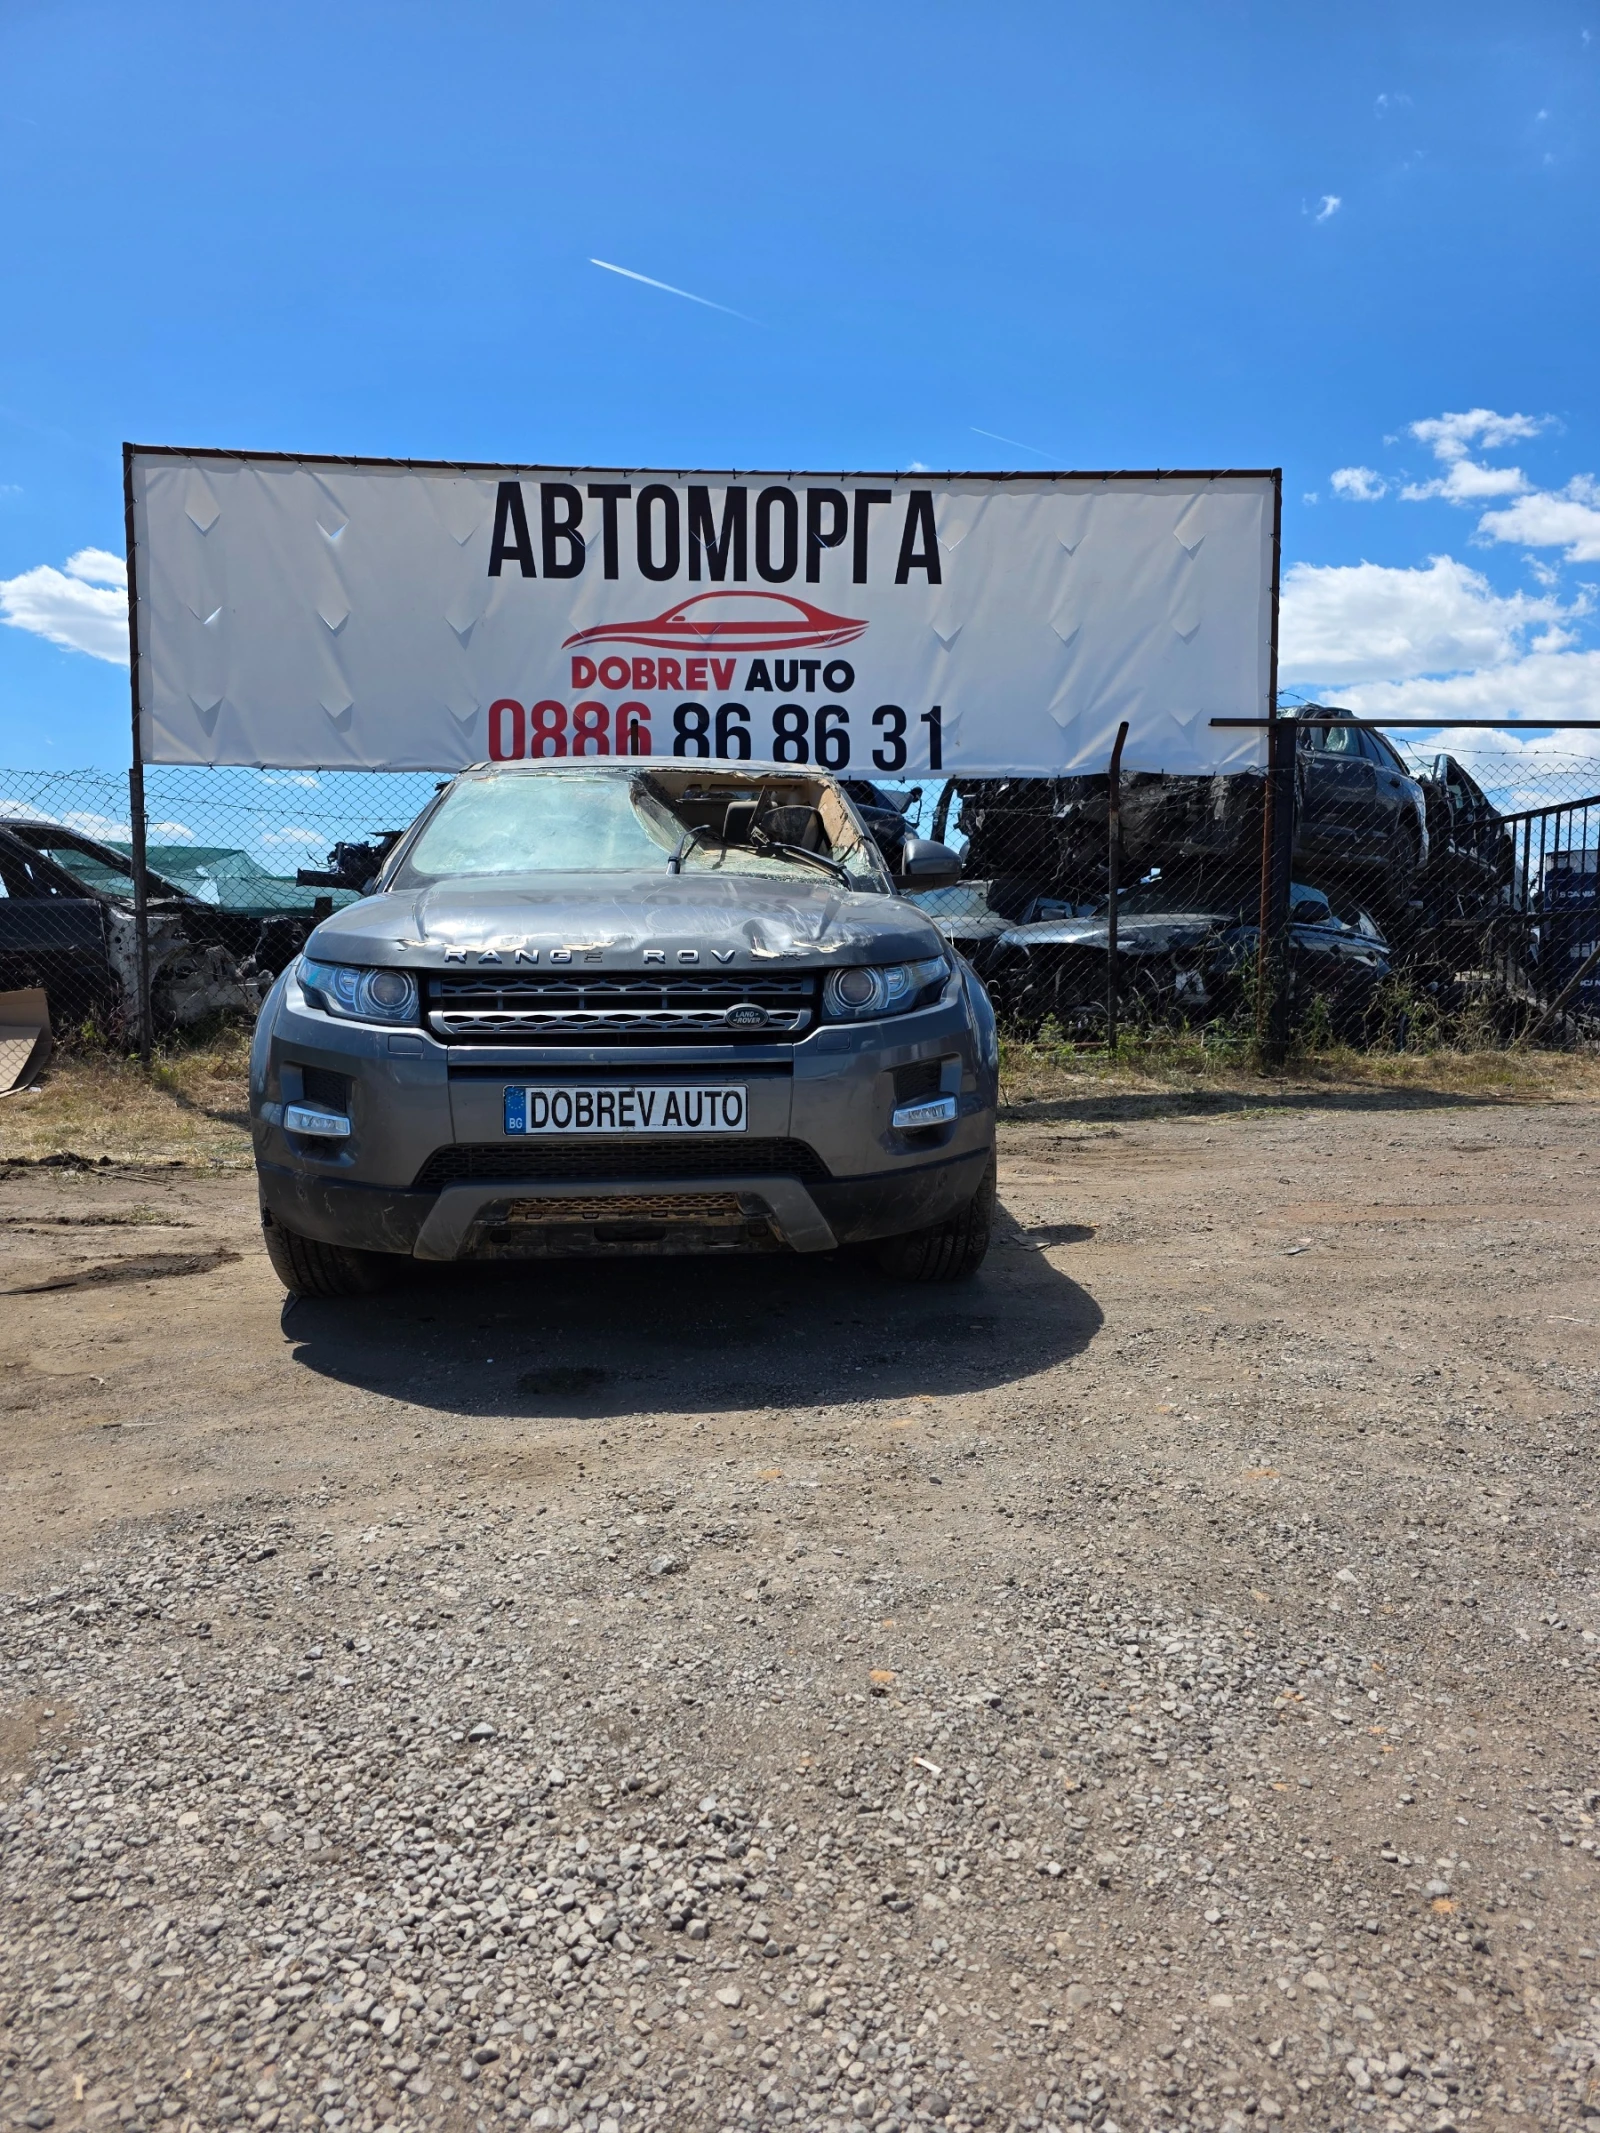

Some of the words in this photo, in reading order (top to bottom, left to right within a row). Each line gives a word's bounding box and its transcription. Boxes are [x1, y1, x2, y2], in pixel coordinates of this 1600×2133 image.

[487, 481, 942, 585] АВТОМОРГА
[571, 656, 737, 691] DOBREV
[744, 659, 855, 693] AUTO
[488, 698, 652, 761] 0886
[673, 702, 752, 760] 86
[772, 704, 850, 770] 86
[872, 704, 942, 771] 31
[444, 949, 603, 964] RANGE
[643, 949, 802, 964] ROVR
[509, 1117, 523, 1129] BG
[530, 1090, 655, 1128] DOBREV
[662, 1090, 743, 1127] AUTO
